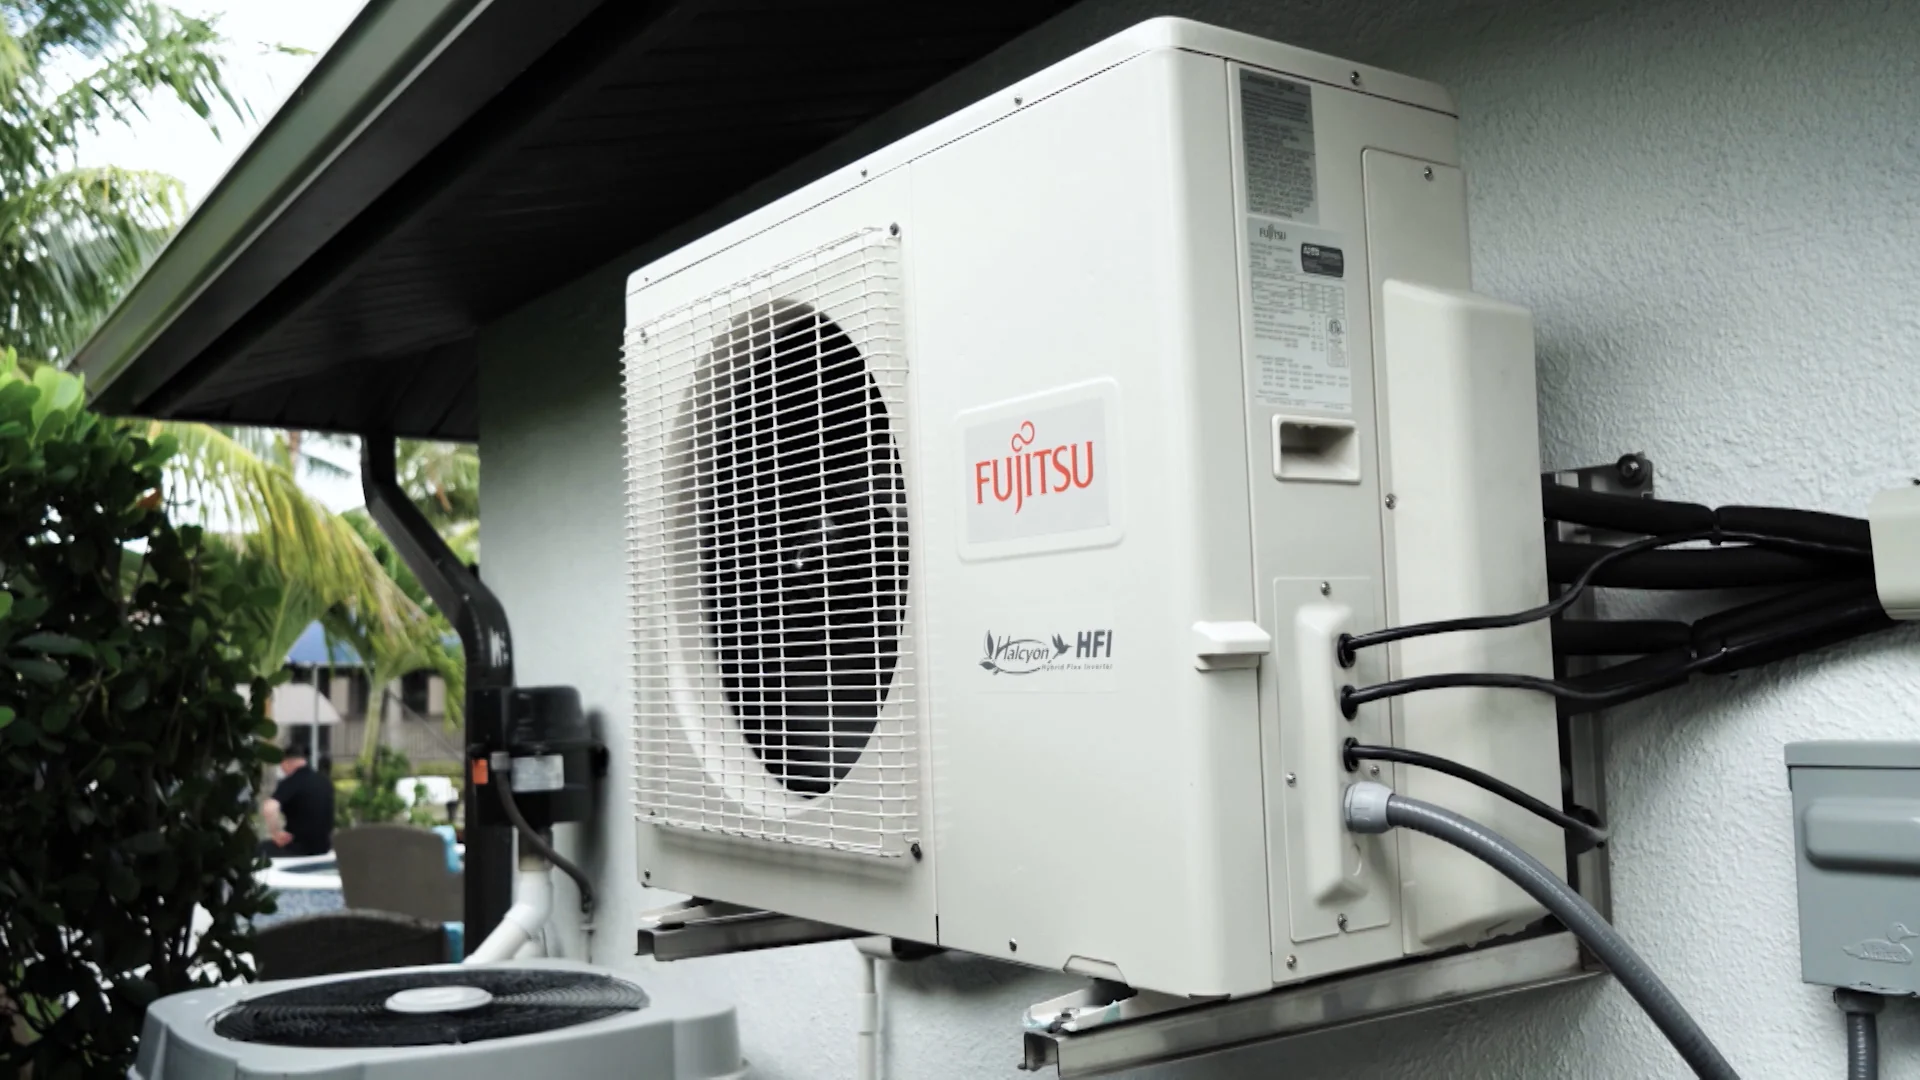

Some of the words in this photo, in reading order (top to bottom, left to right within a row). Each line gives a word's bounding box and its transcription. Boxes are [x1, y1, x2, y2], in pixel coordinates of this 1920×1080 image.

[975, 421, 1094, 514] FUJITSU
[995, 634, 1050, 664] Halcyon
[1075, 629, 1113, 659] HFI
